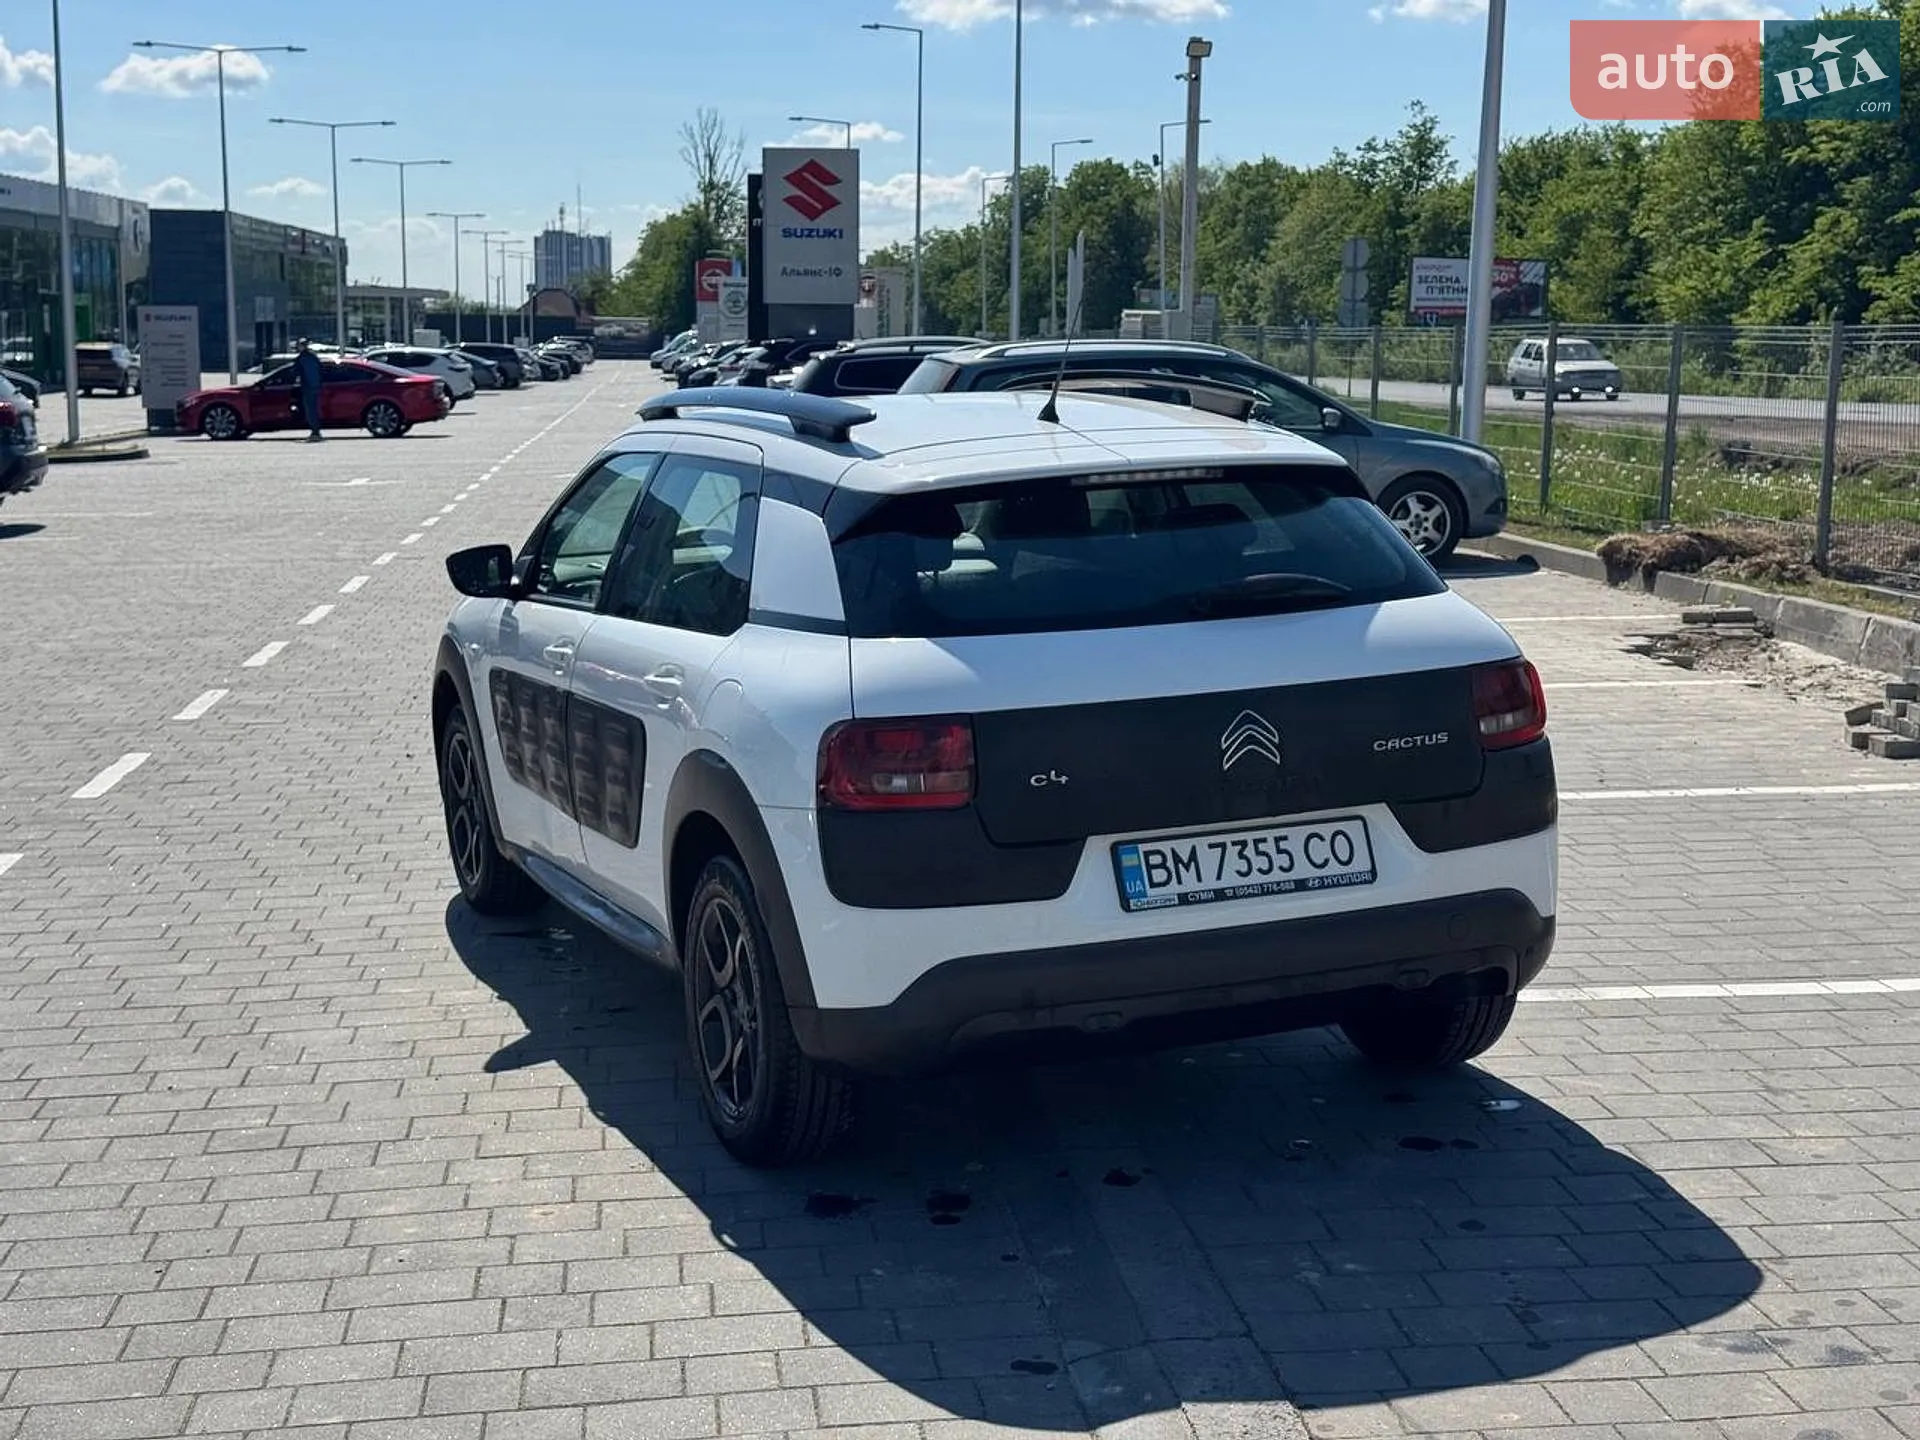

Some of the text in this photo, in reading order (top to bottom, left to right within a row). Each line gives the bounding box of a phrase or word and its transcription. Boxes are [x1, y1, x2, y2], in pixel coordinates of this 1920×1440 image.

[781, 227, 844, 239] SUZUKI
[1426, 285, 1469, 296] П'ЯТНИ
[1373, 731, 1449, 752] CACTUS
[1030, 769, 1069, 786] C4
[1143, 828, 1355, 889] BM 7355 CO
[1126, 879, 1145, 894] UA
[1323, 871, 1373, 887] HYUNDAI
